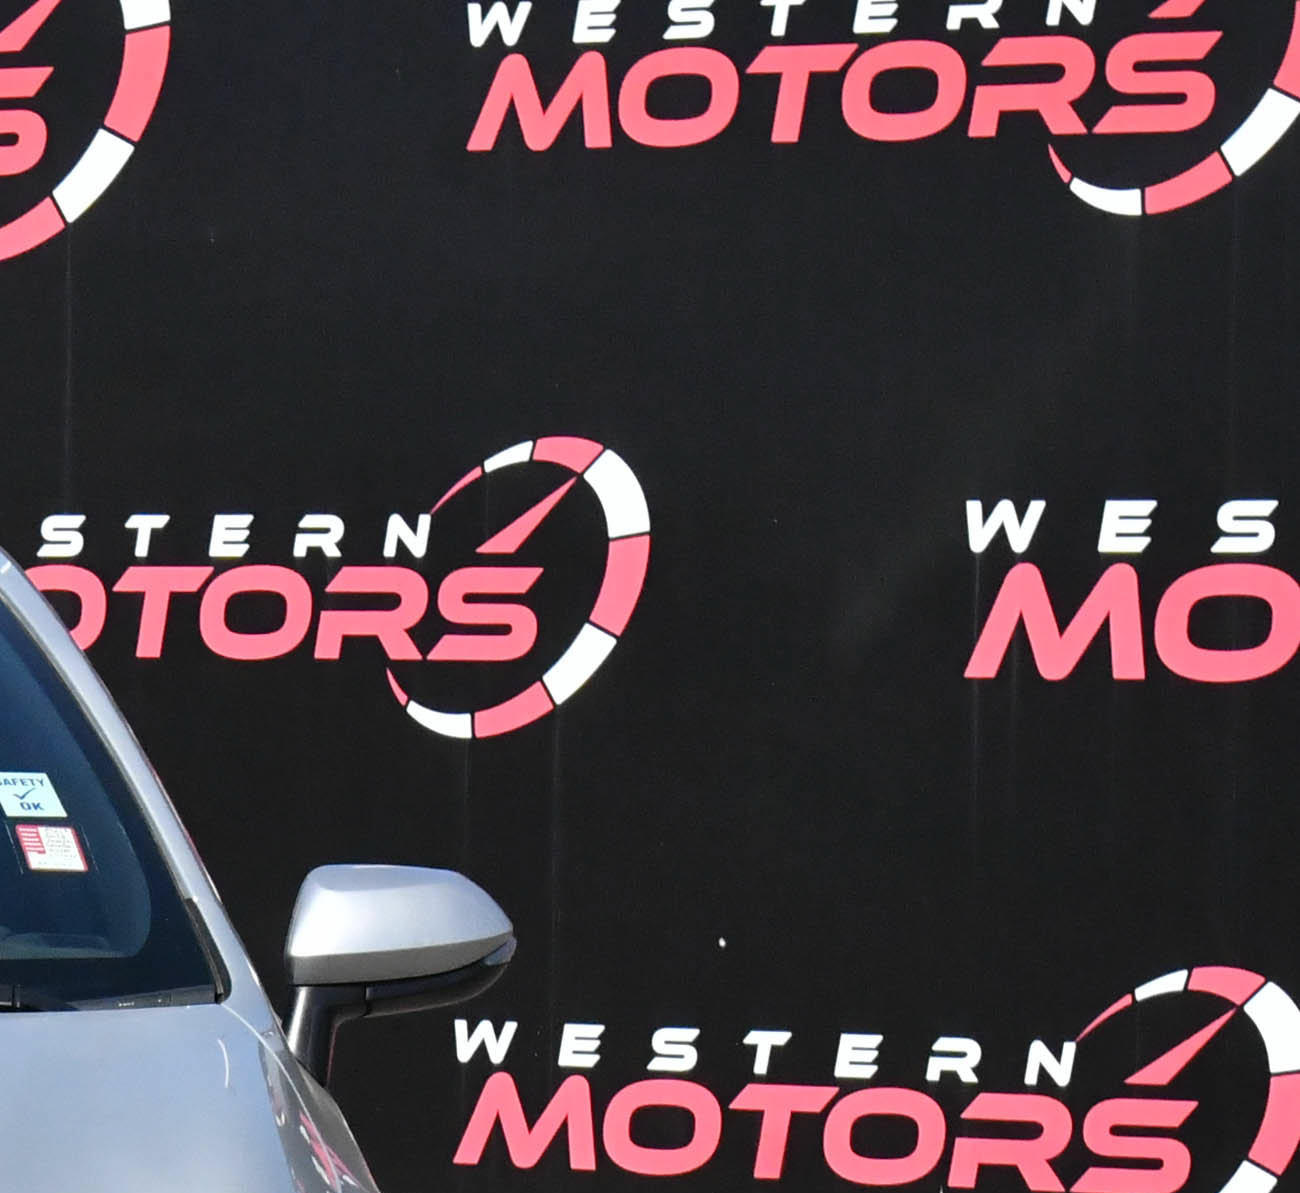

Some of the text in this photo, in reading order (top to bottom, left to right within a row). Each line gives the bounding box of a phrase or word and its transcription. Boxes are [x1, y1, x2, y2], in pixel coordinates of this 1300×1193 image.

[466, 30, 1223, 152] MOTORS
[965, 498, 1279, 554] WES
[963, 562, 1300, 684] MO
[19, 801, 45, 811] OK
[454, 1018, 1077, 1087] WESTERN
